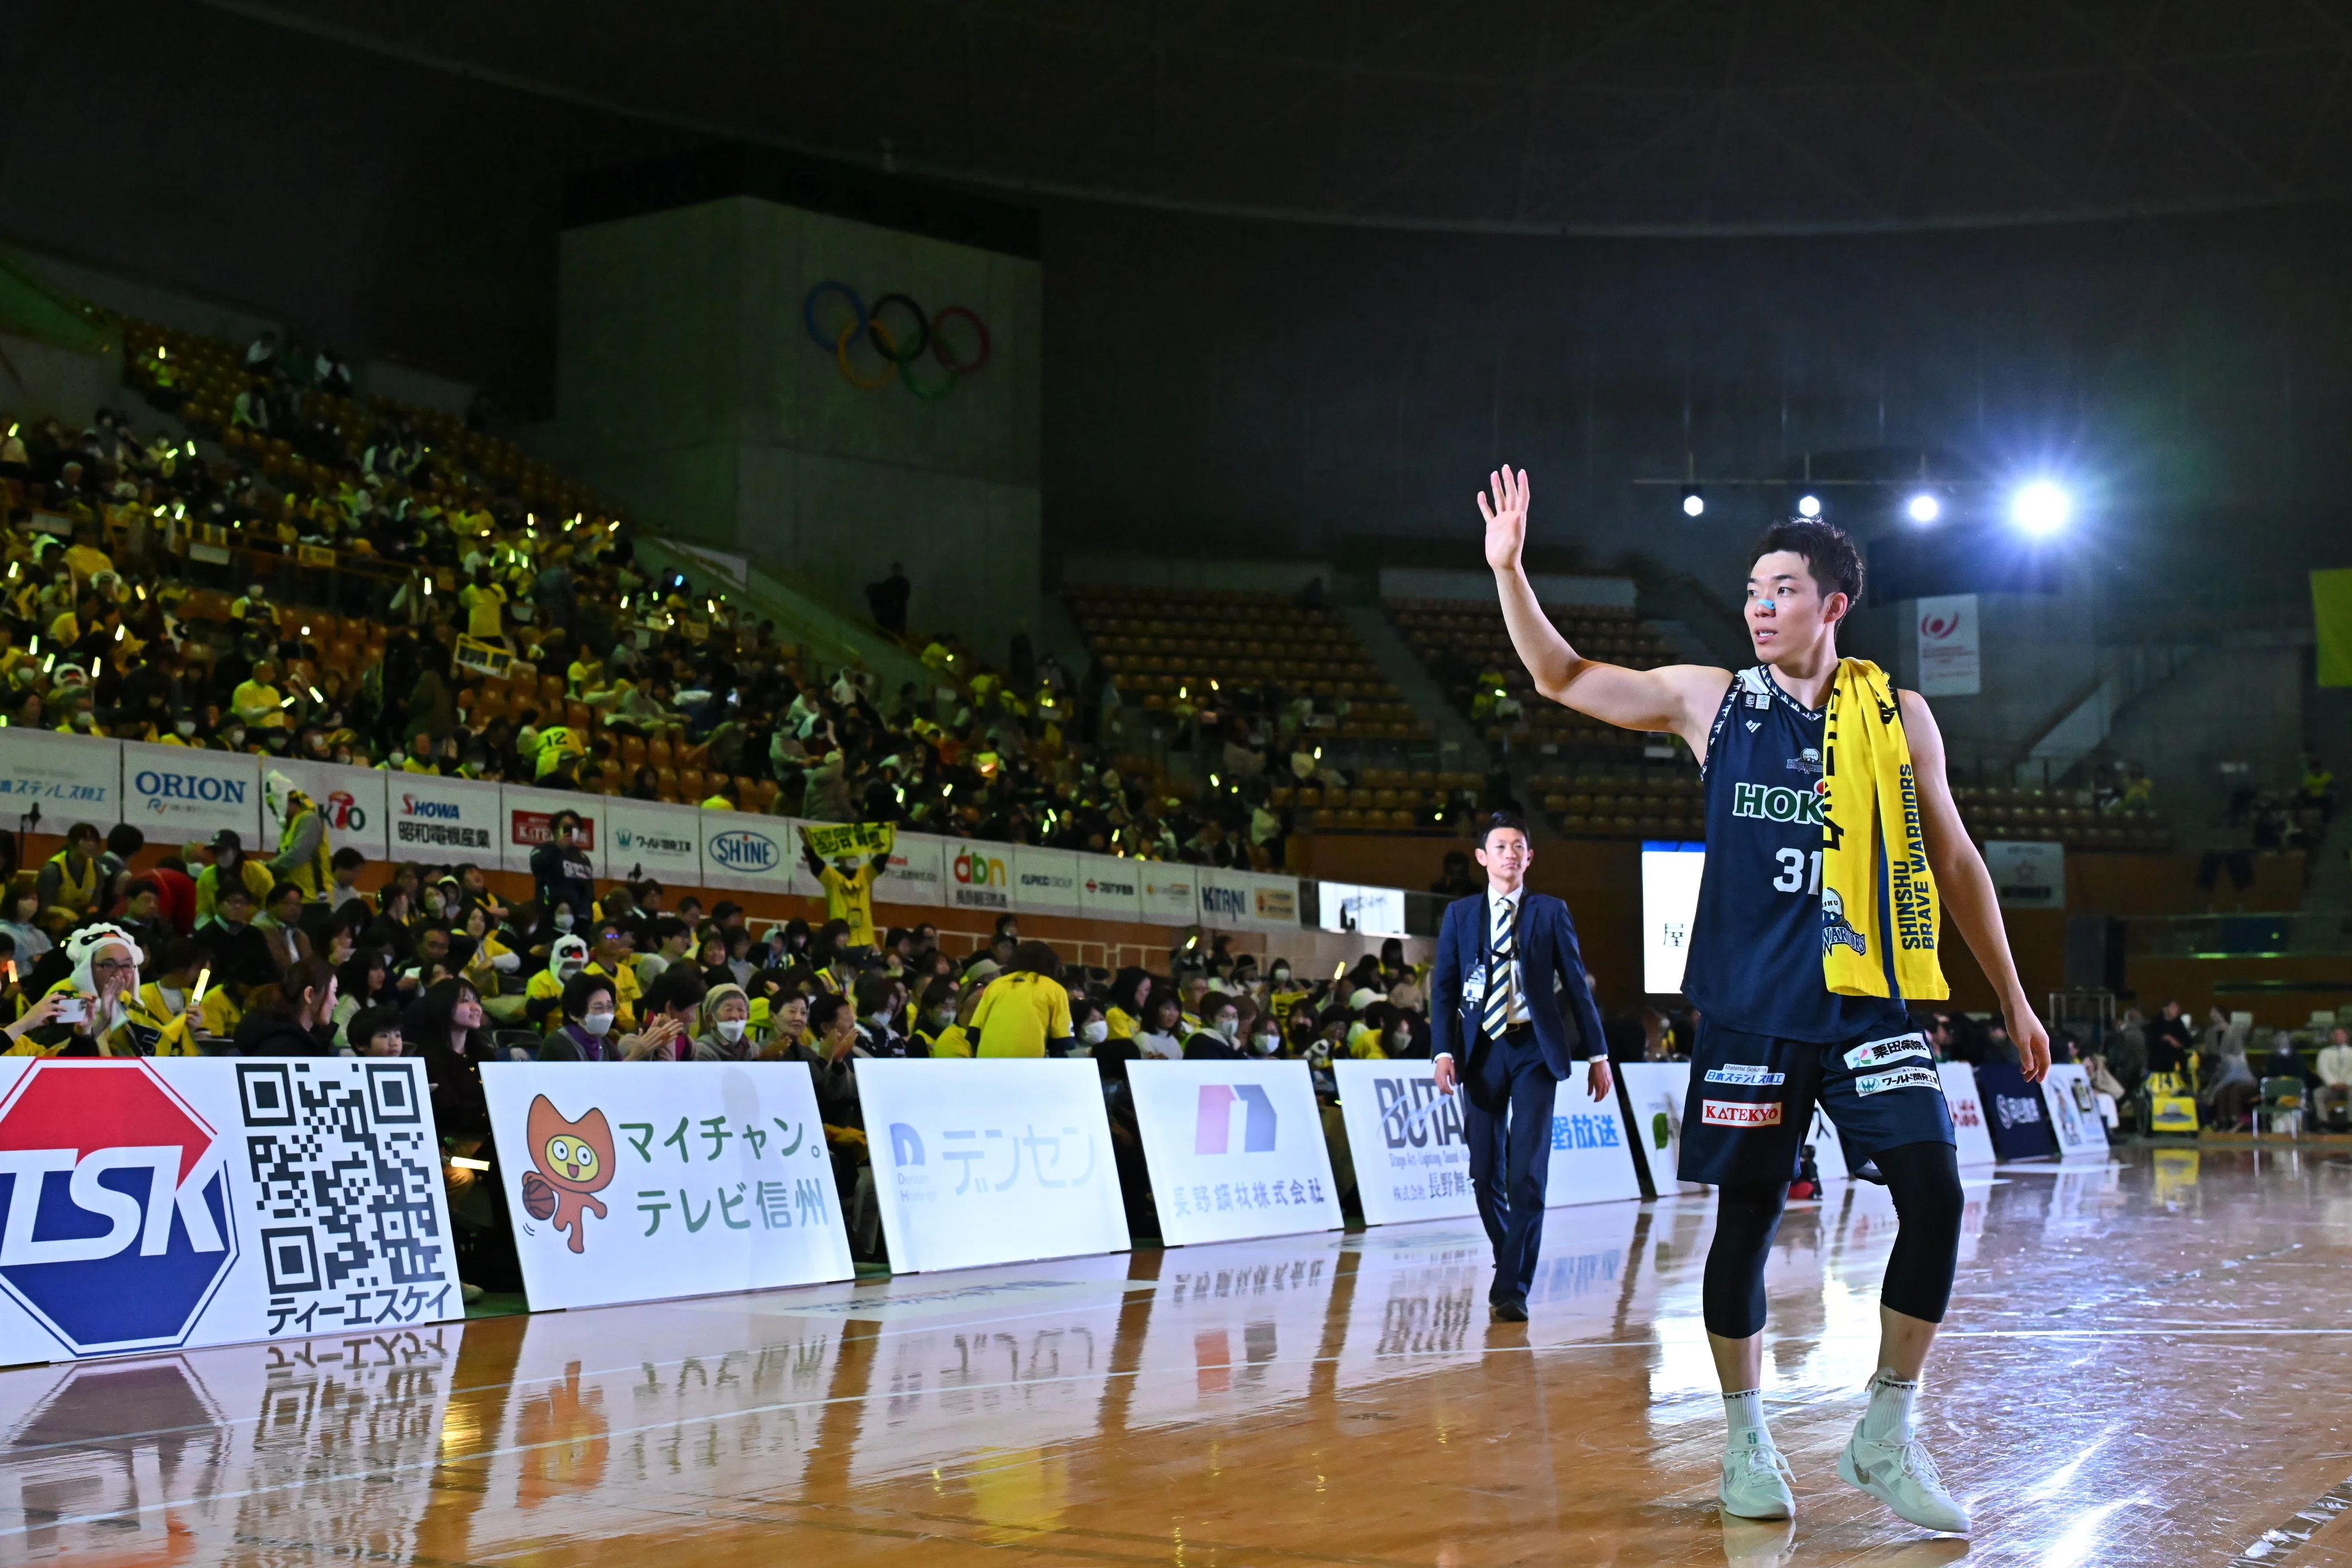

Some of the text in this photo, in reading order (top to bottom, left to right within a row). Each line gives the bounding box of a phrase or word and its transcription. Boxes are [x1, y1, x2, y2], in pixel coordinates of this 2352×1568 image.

[545, 732, 567, 747] 12
[136, 771, 247, 803] ORION
[400, 793, 459, 819] SHOWA
[1900, 763, 1926, 873] WARRIORS
[954, 846, 1006, 886] abn
[1774, 847, 1822, 895] 31
[1893, 861, 1920, 950] SHINSHU
[1914, 881, 1935, 949] BRAVE
[1705, 1105, 1778, 1121] KATEKYO
[619, 1115, 820, 1163] マイチャン。
[942, 1124, 1095, 1196] デンセン
[0, 1145, 225, 1266] TSK
[636, 1178, 828, 1237] テレビ信州
[267, 1284, 452, 1336] ティーエスケイ
